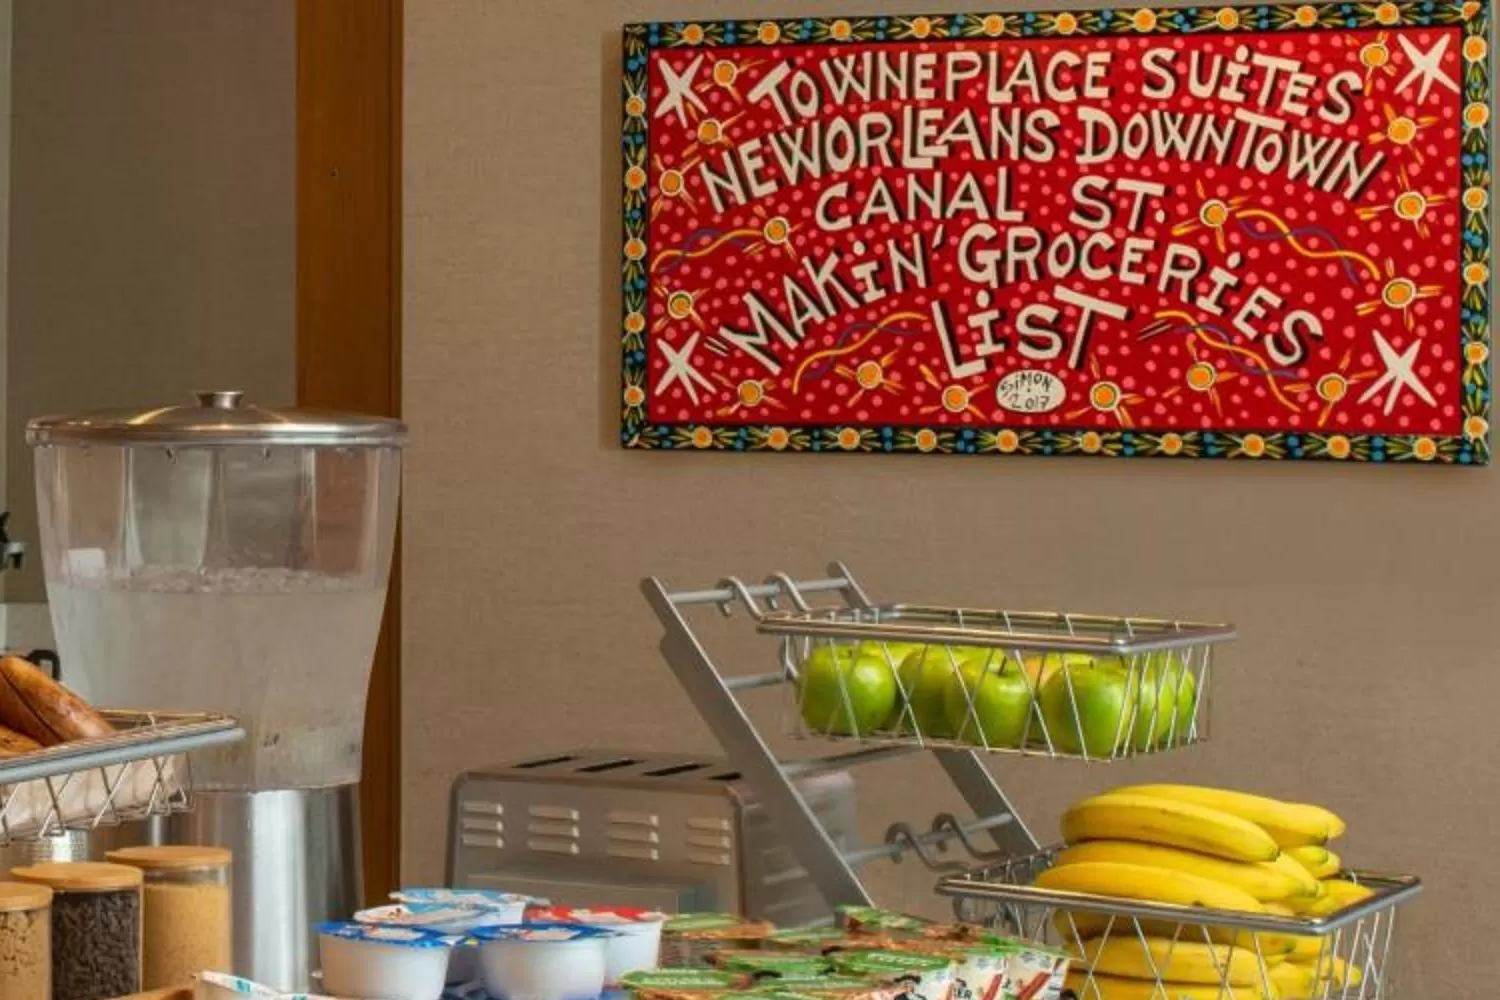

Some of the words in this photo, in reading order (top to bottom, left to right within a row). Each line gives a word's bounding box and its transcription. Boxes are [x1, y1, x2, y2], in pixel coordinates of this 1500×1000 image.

[747, 50, 1111, 126] TOWNEPLACE
[1076, 105, 1384, 200] DOWNTOWN
[815, 166, 1025, 231] CANAL
